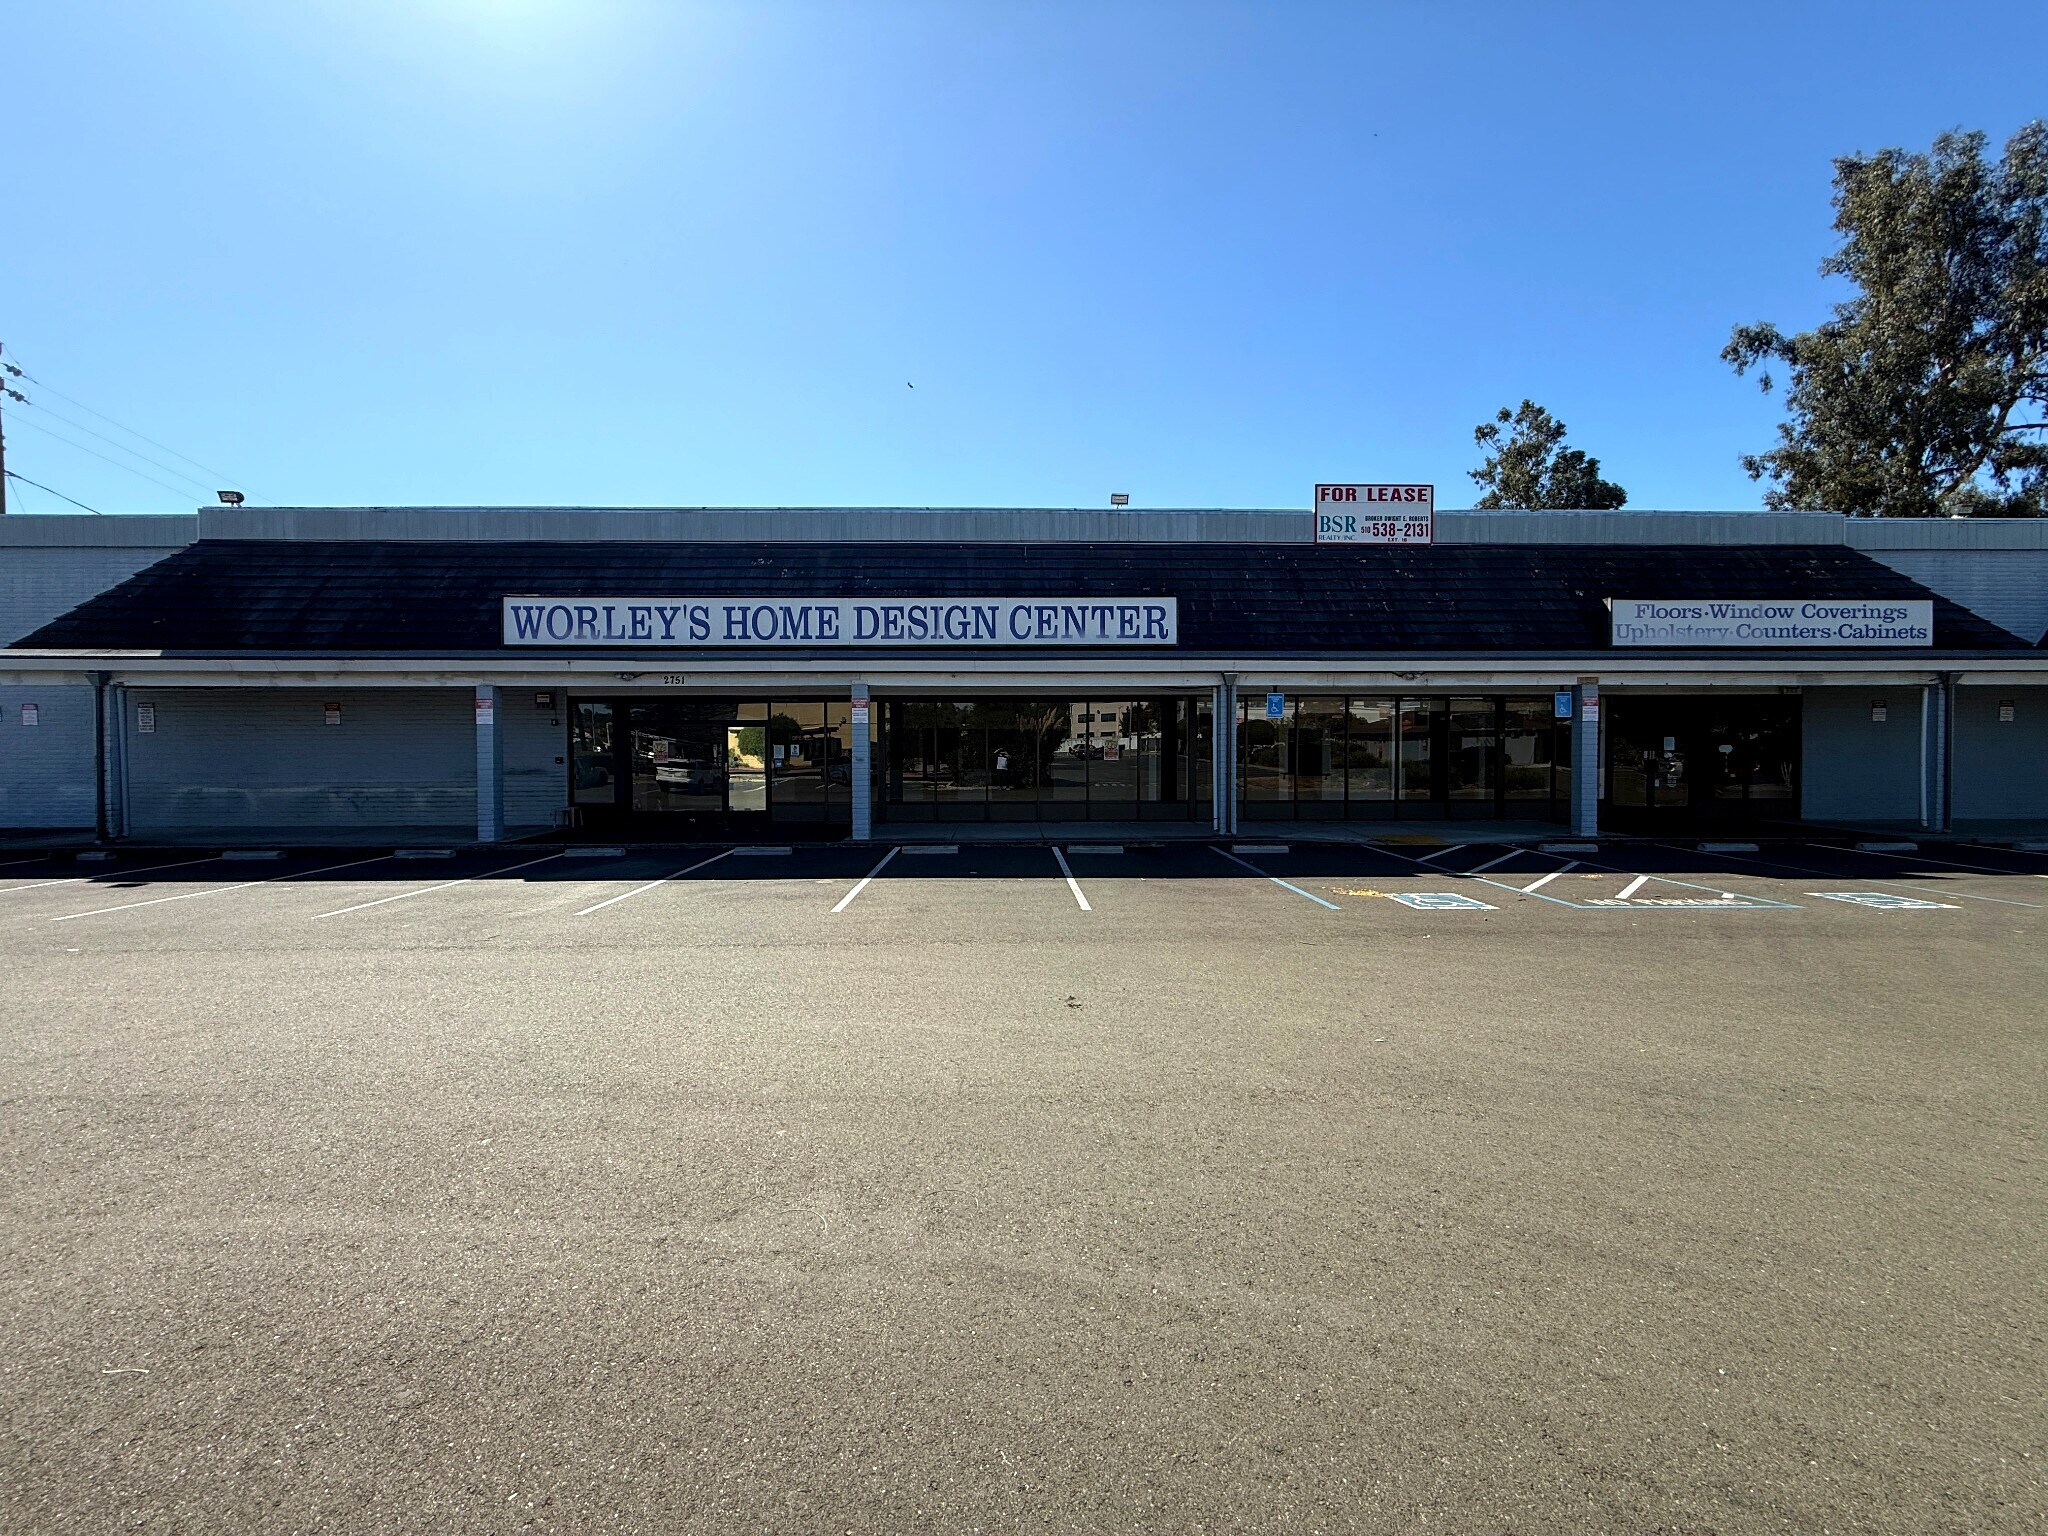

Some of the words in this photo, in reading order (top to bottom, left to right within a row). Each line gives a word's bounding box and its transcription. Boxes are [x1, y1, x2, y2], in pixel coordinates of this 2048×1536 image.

[1320, 488, 1357, 502] FOR
[1367, 487, 1428, 502] LEASE
[1319, 515, 1357, 533] BSR
[1372, 522, 1429, 537] 538-2131
[1801, 603, 1908, 623] Coverings
[511, 604, 711, 640] WORLEY'S
[723, 604, 840, 641] HOME
[853, 604, 998, 641] DESIGN
[1008, 604, 1170, 641] CENTER
[663, 675, 685, 685] 2751
